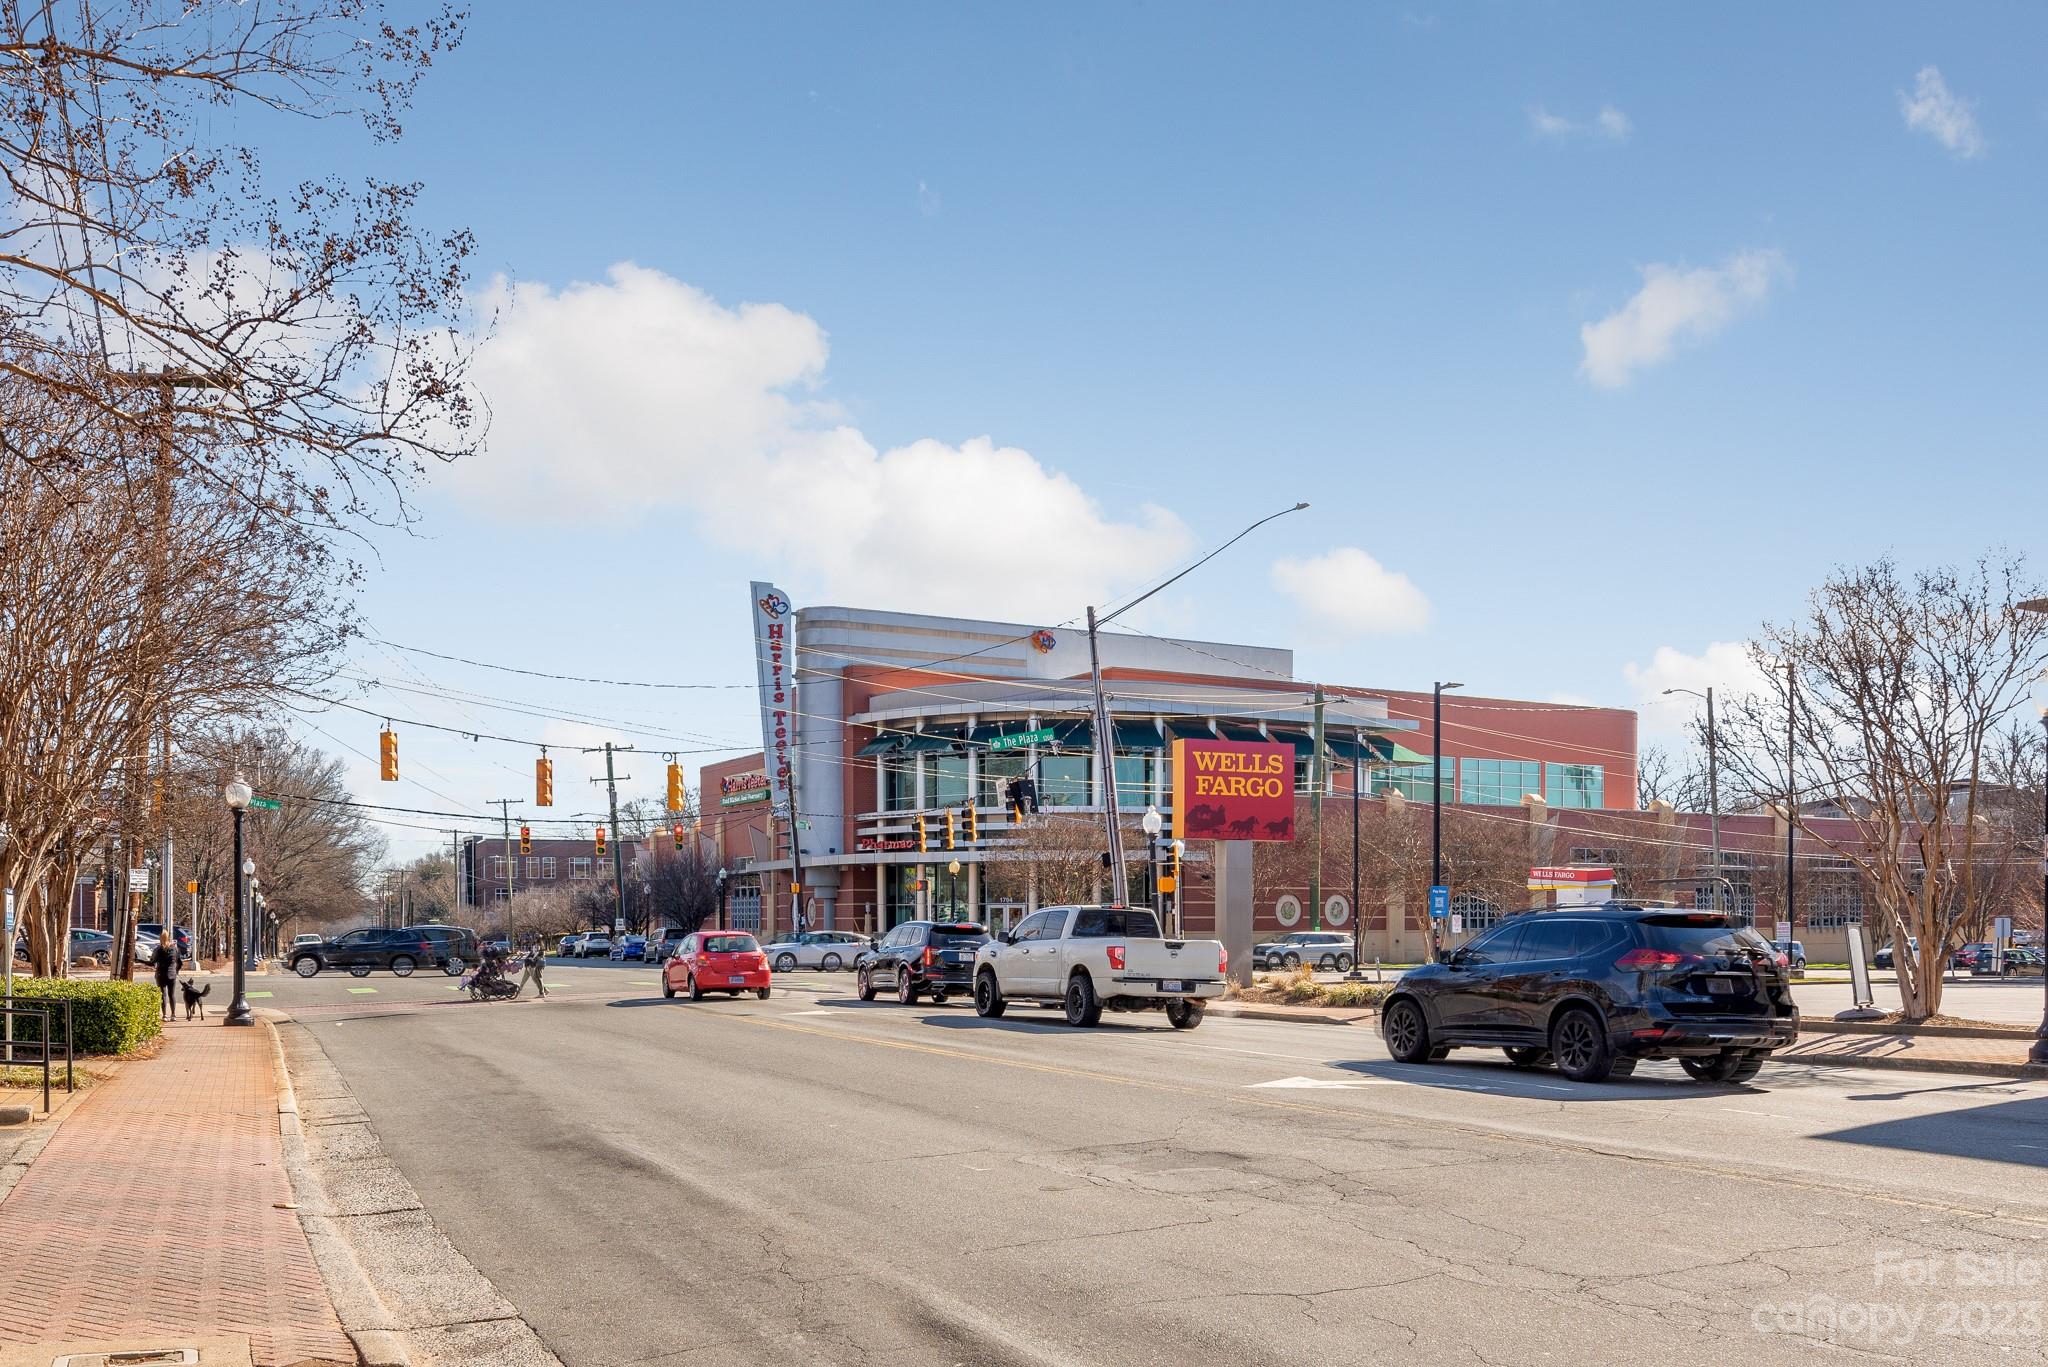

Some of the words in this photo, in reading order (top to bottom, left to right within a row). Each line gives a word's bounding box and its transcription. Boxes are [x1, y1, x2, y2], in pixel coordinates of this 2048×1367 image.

[768, 623, 785, 703] Harris
[773, 710, 788, 791] Teeter
[1003, 738, 1017, 747] The
[1019, 734, 1039, 745] Plaza
[1192, 751, 1284, 775] WELLS
[1195, 775, 1283, 798] FARGO
[1554, 871, 1575, 879] FARGO
